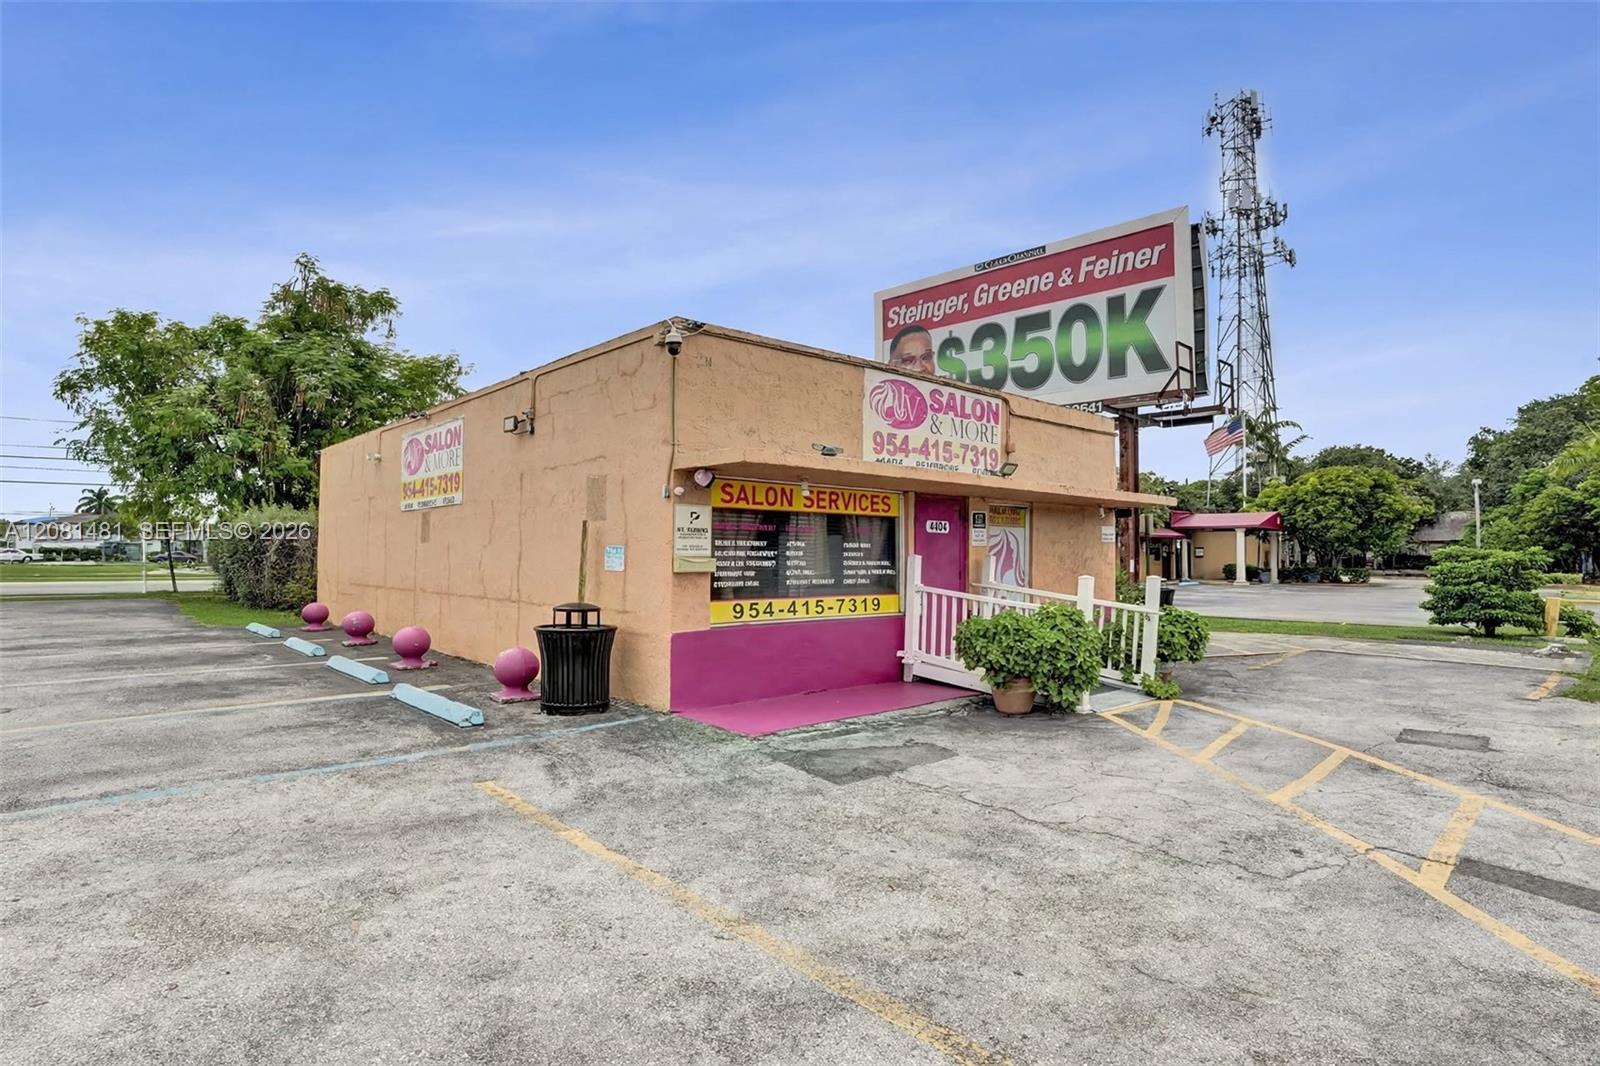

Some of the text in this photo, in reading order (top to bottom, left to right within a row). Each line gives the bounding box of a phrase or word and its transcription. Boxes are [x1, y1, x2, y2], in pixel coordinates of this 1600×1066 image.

[886, 242, 1168, 329] Steinger, Greene & Feiner
[936, 283, 1173, 391] $350K
[929, 388, 1000, 426] SALON
[424, 425, 462, 455] SALON
[930, 414, 999, 445] & MORE
[432, 447, 460, 472] MORE
[872, 431, 999, 470] 954-415-7319
[720, 483, 891, 513] SALON SERVICES
[929, 521, 948, 532] 4404
[733, 597, 881, 620] 954-415-7319
